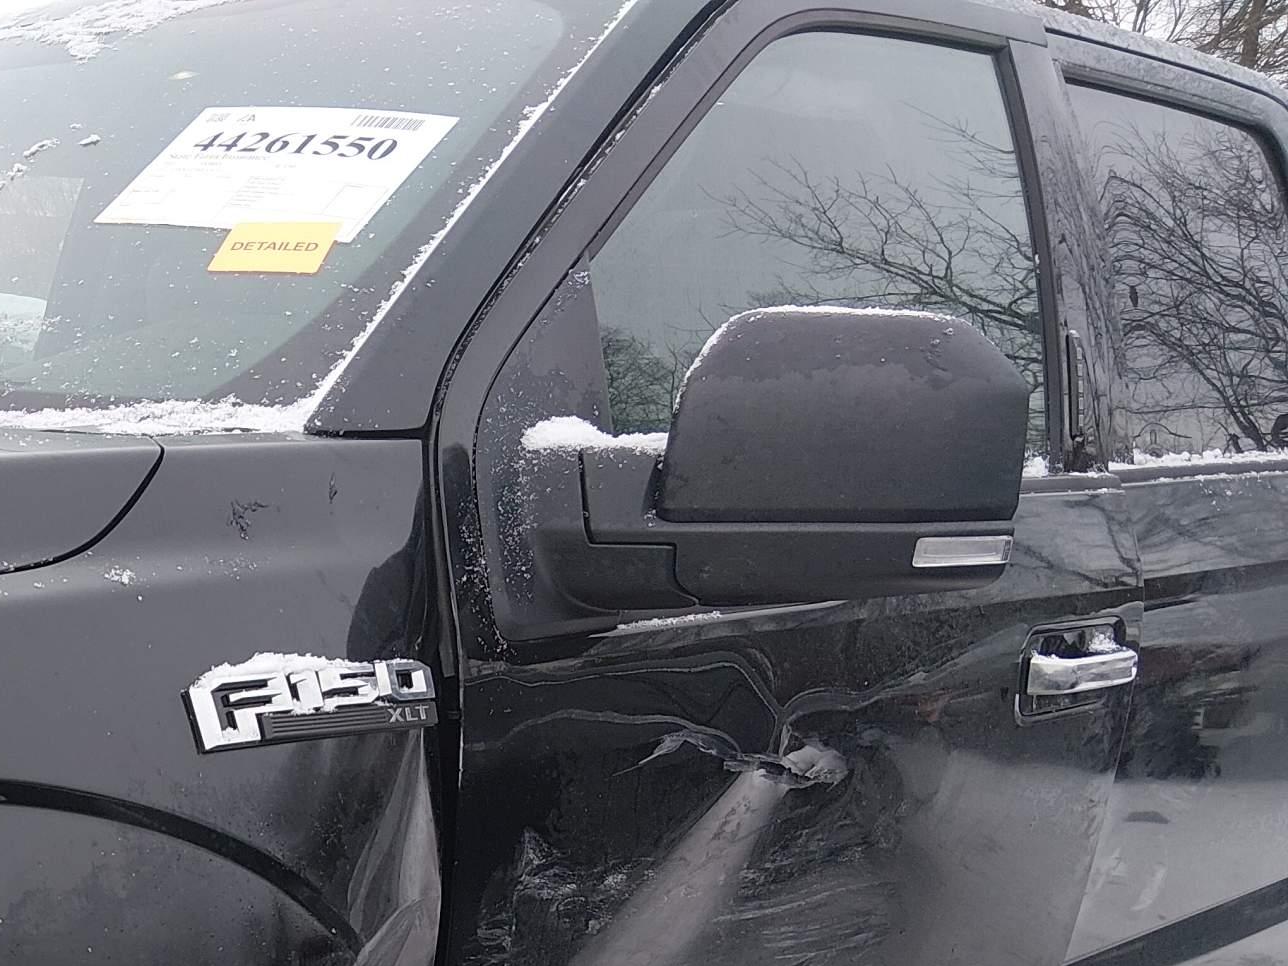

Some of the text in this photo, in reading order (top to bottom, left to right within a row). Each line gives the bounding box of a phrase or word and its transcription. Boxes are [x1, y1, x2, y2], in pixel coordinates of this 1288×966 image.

[194, 131, 398, 160] 44261550
[231, 241, 319, 252] DETAILED
[387, 704, 429, 723] XLT
